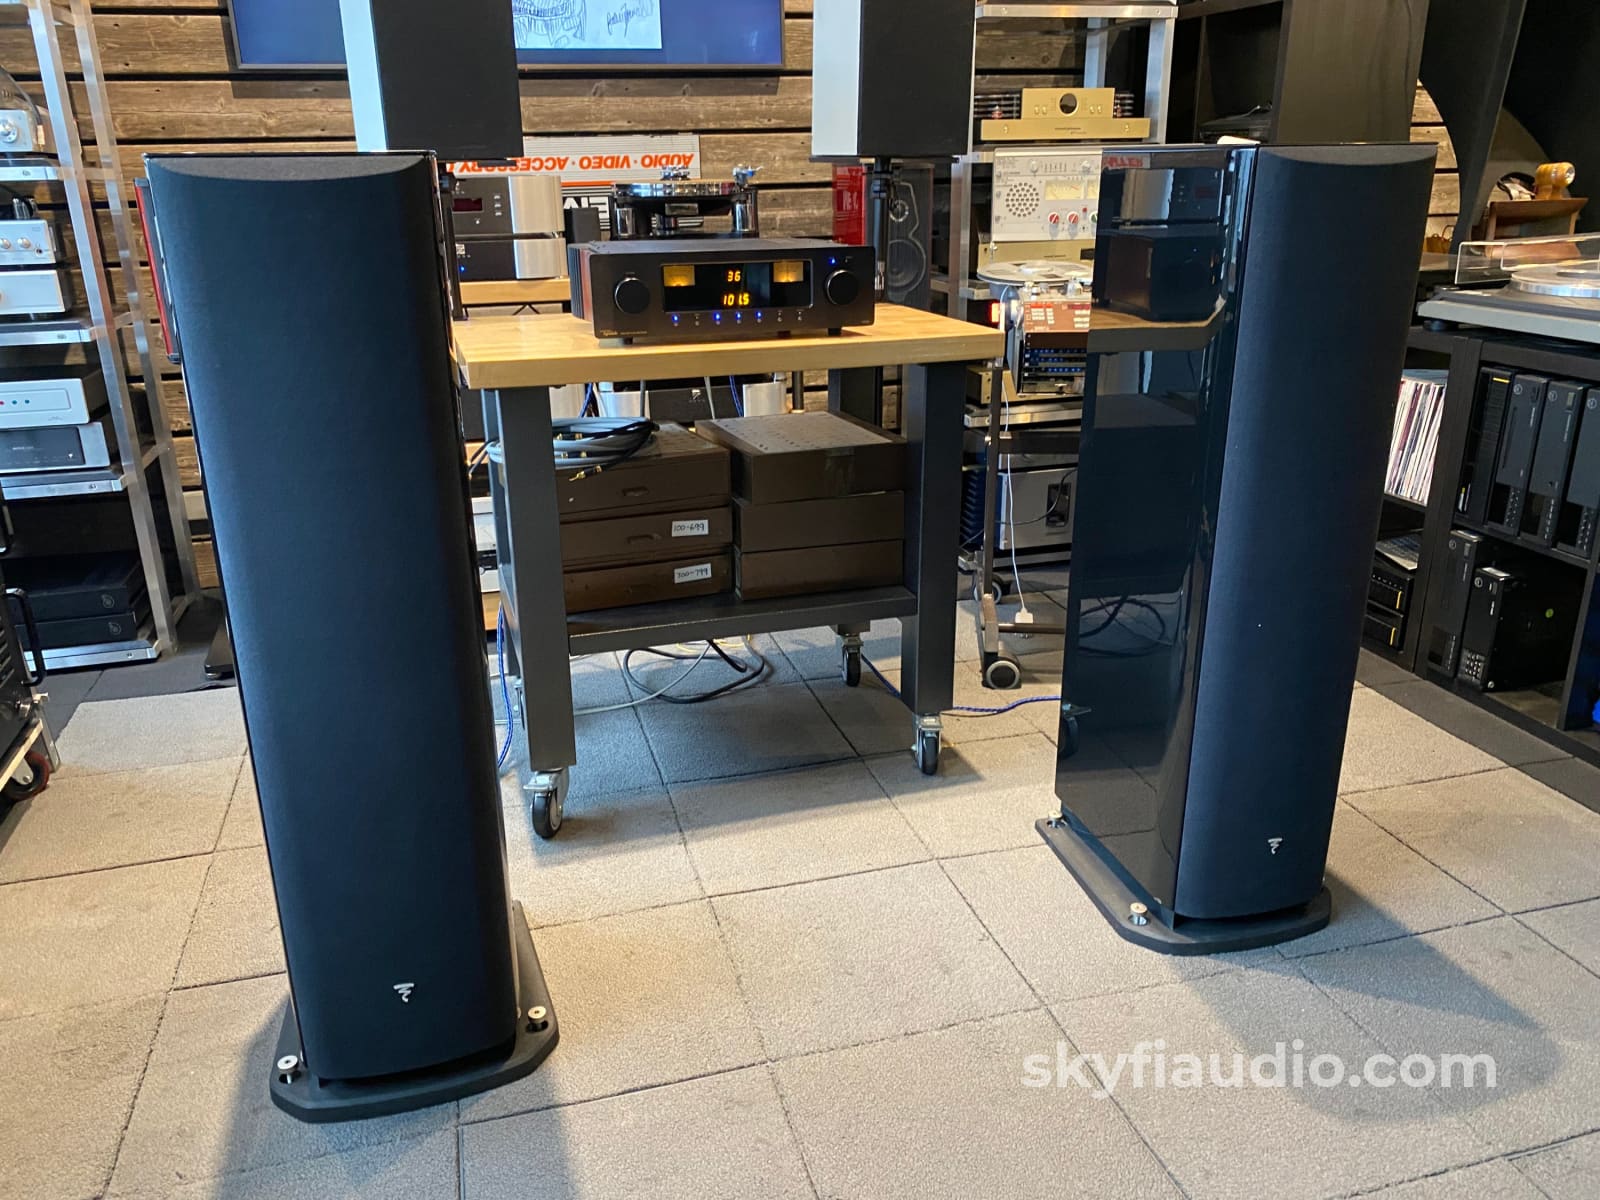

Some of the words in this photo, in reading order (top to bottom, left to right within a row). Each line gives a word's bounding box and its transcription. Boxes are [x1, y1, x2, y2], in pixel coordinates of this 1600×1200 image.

[578, 154, 631, 170] VIDEO
[640, 153, 694, 169] AUDIO
[727, 270, 741, 282] 36
